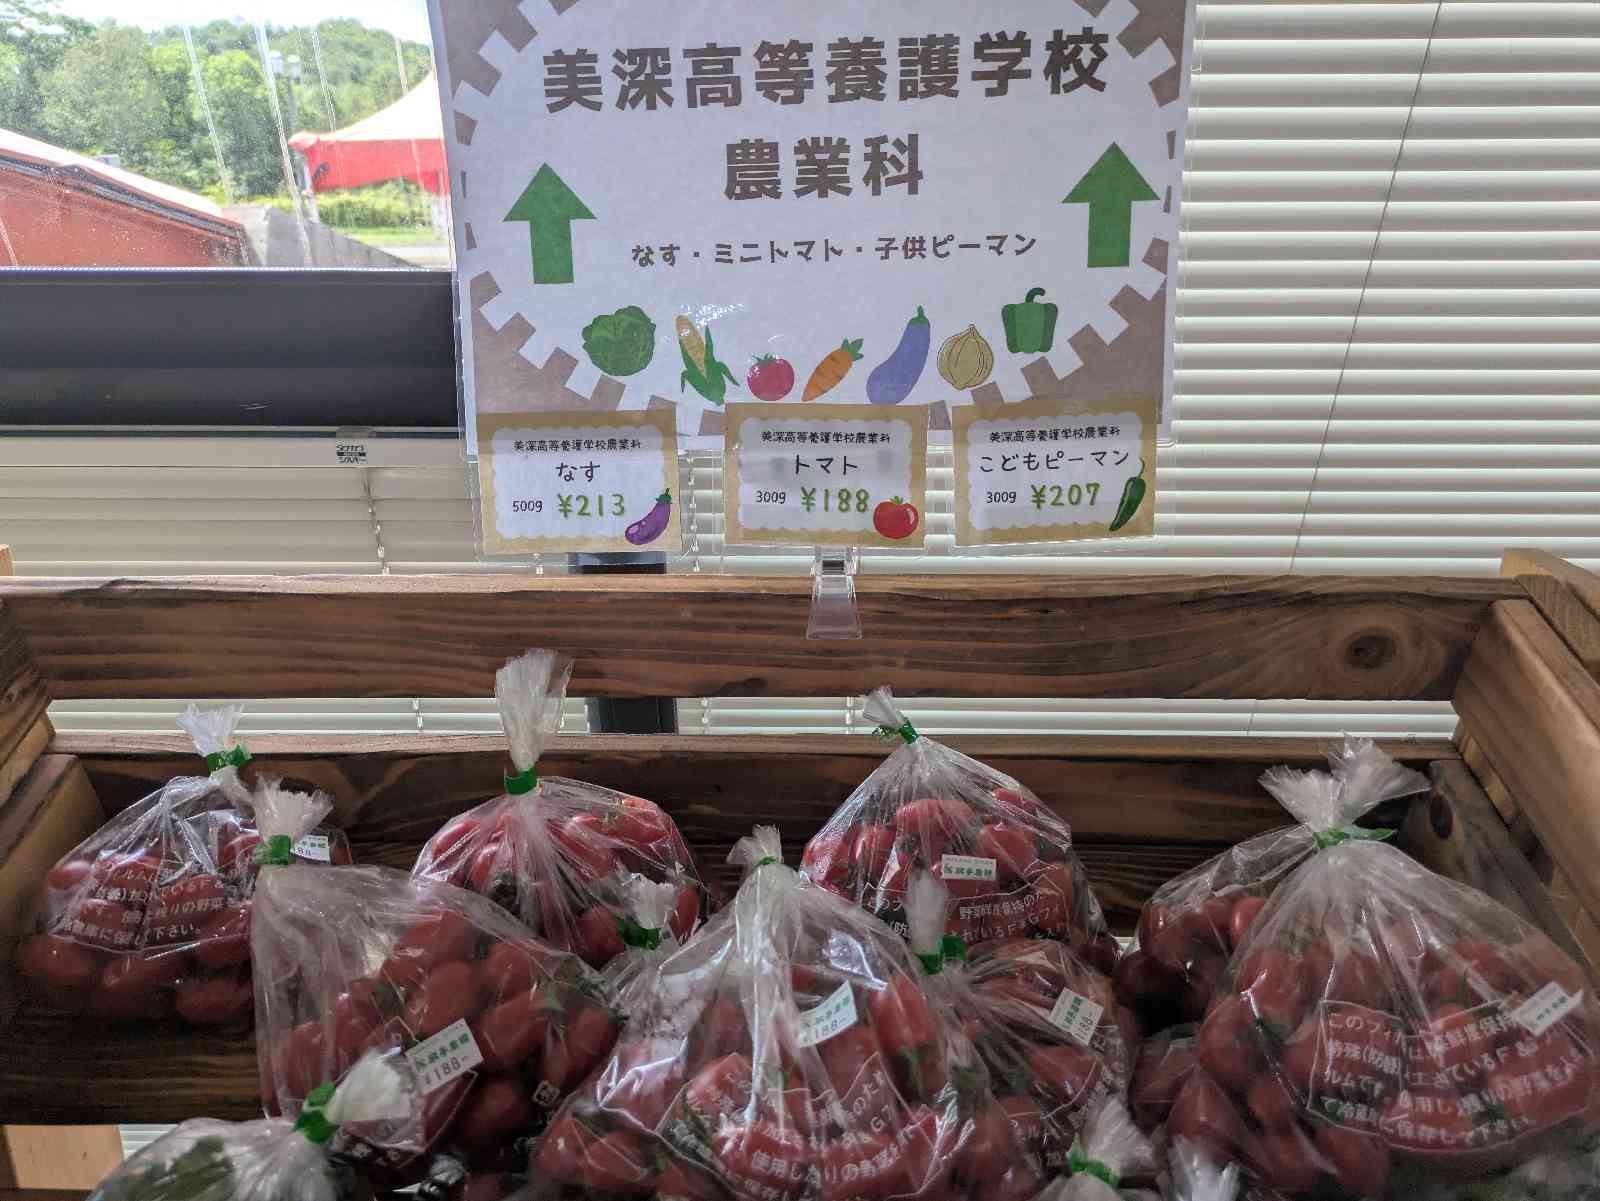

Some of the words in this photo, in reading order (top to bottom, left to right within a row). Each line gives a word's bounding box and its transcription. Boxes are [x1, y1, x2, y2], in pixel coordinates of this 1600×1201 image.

[542, 27, 1111, 113] 美深高等養護学校
[723, 133, 924, 202] 農業科
[555, 460, 601, 483] なす
[795, 454, 859, 476] トマト
[979, 450, 1129, 473] こどもピーマン
[512, 499, 543, 513] 500g
[557, 493, 626, 518] ¥213
[755, 490, 787, 505] 300g
[801, 486, 870, 513] ¥188
[986, 490, 1017, 504] 300g
[1030, 482, 1100, 509] ¥207
